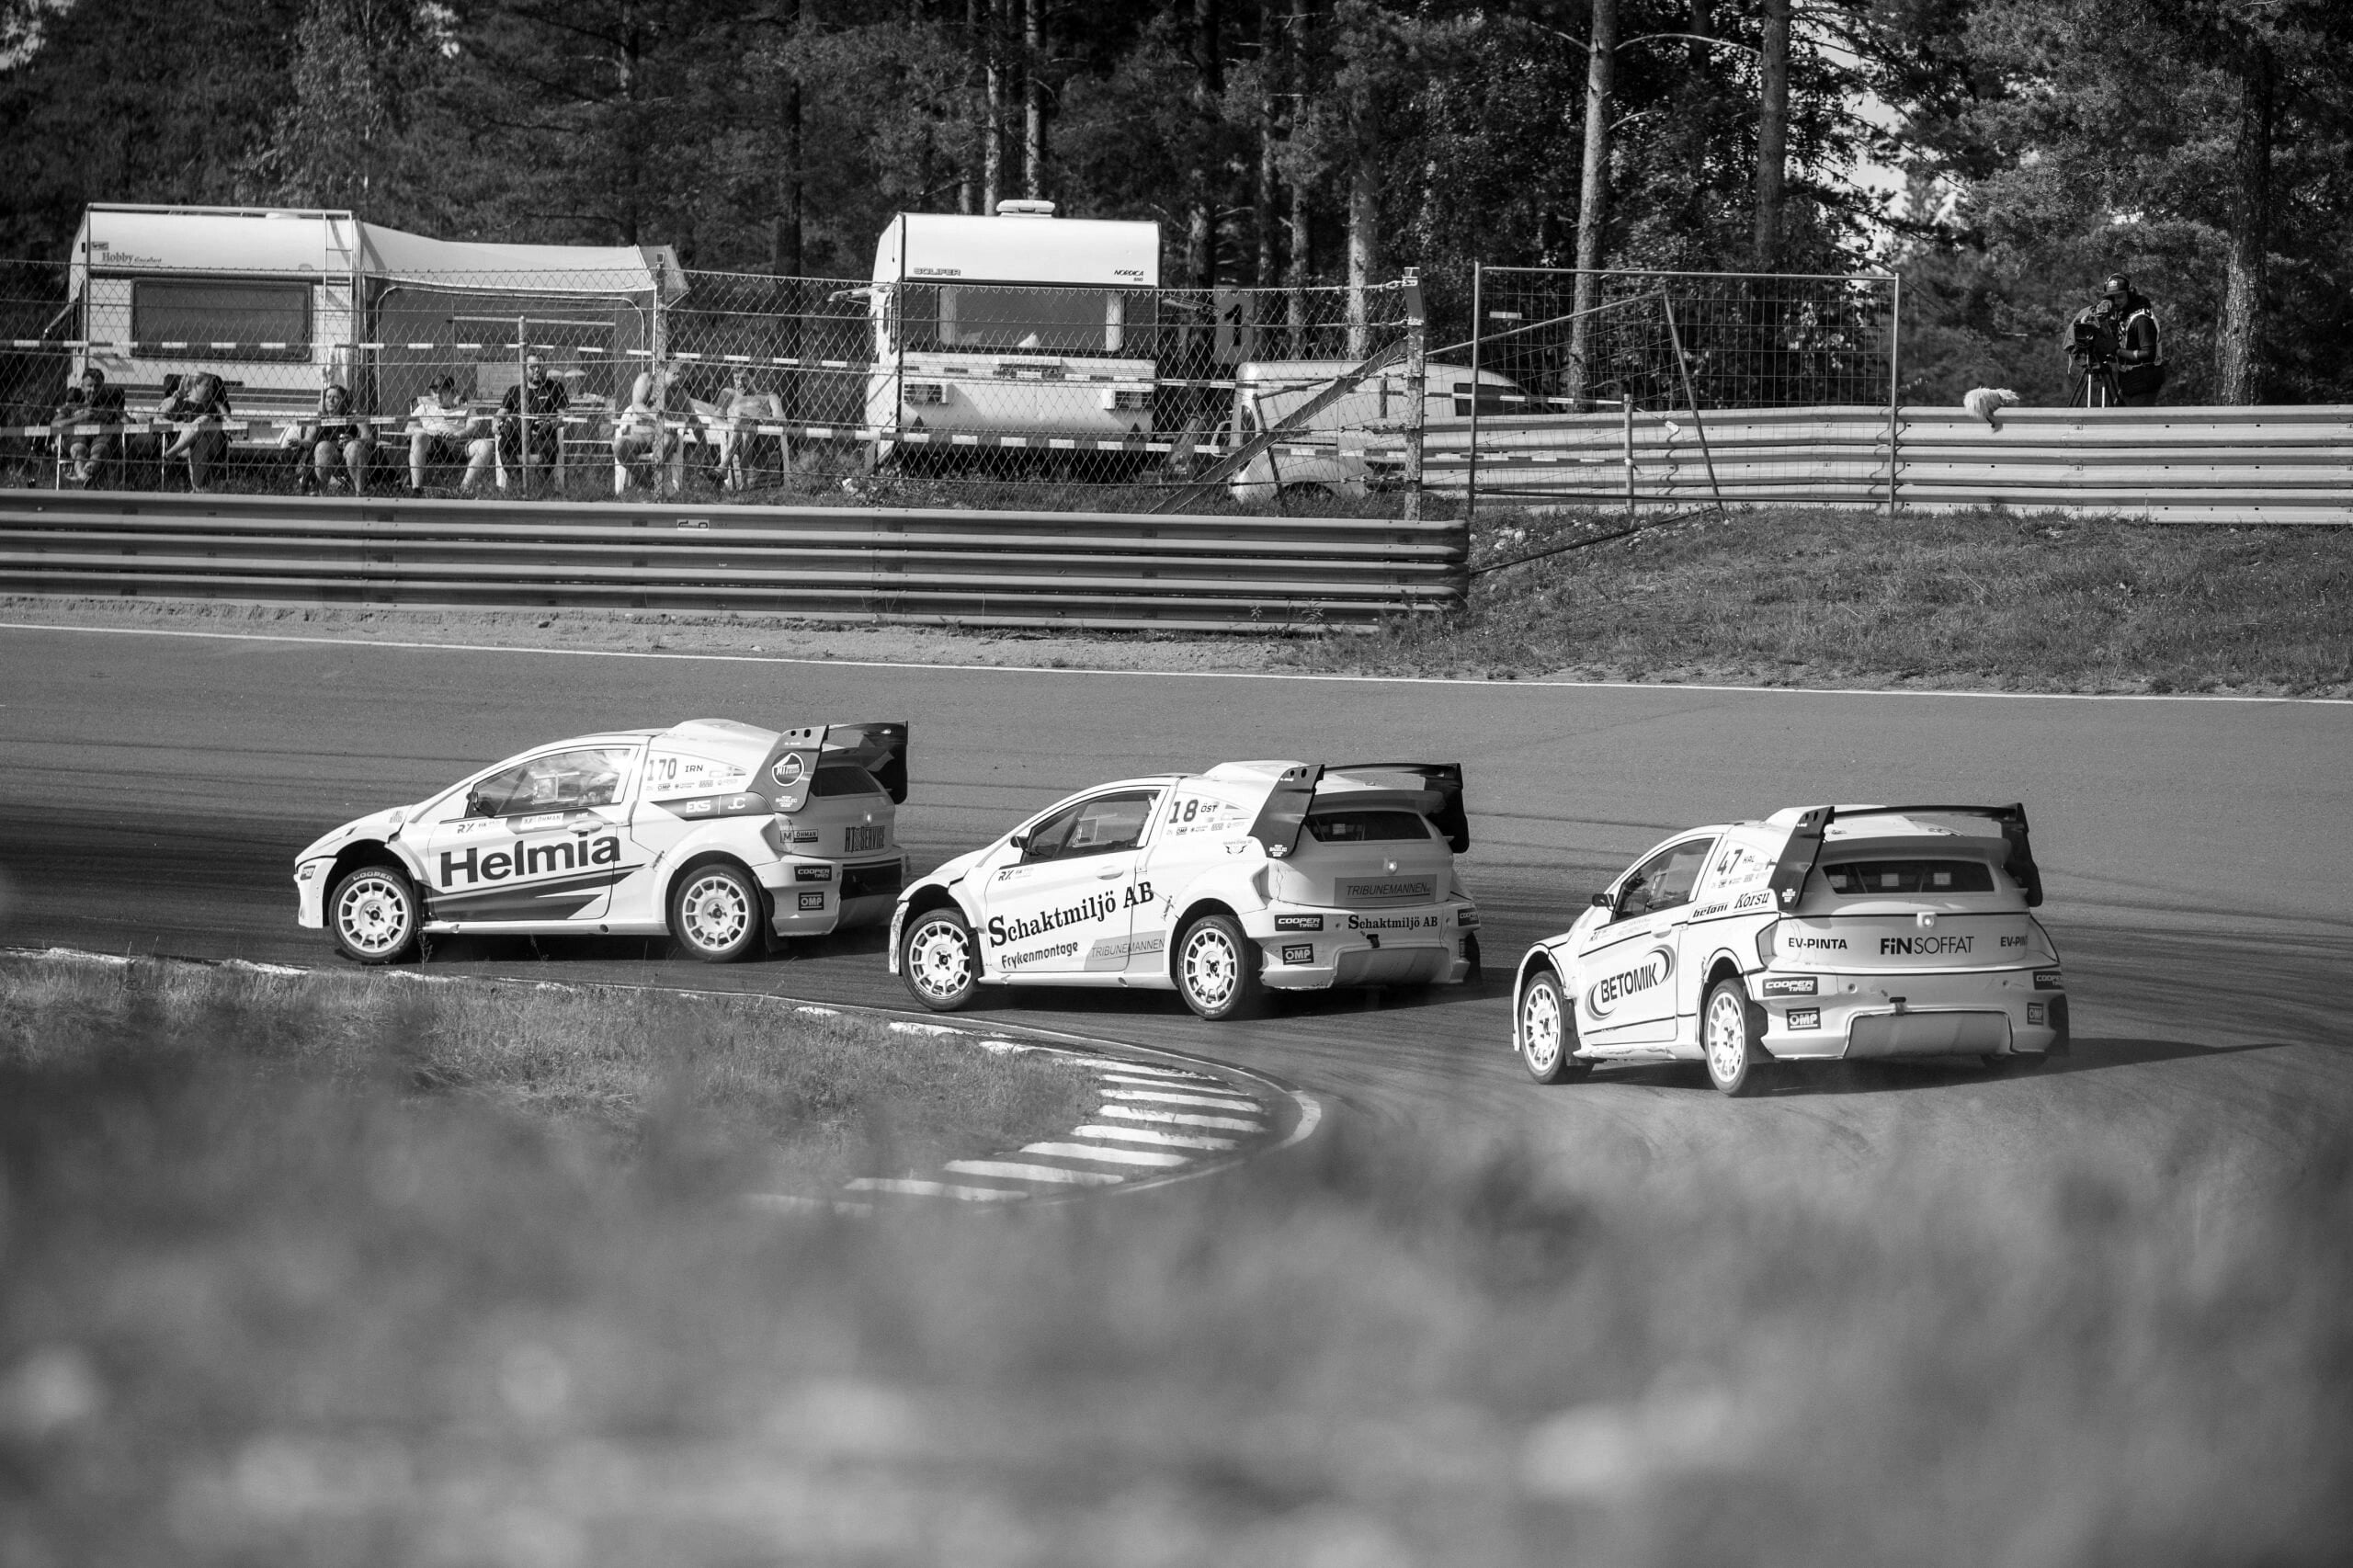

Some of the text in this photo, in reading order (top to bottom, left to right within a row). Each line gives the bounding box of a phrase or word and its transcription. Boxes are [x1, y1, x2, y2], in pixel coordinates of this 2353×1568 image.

[103, 253, 133, 265] Hobby
[1224, 303, 1243, 347] 1
[647, 757, 703, 781] 170 IRN
[1169, 799, 1199, 824] 18
[441, 831, 620, 887] Helmia
[1717, 848, 1744, 875] 47
[1346, 881, 1428, 897] TRIBUNEMANNEN
[801, 896, 823, 906] OMP
[1733, 892, 1770, 909] Korsu
[988, 881, 1154, 949] Schaktmiljö AB
[1348, 915, 1438, 931] Schaktmiljö AB
[1091, 937, 1165, 960] TRIBUNEMANNEN
[1788, 937, 1847, 949] EV-PINTA
[1001, 941, 1079, 970] Frykenmontage
[1285, 949, 1312, 960] OMP
[1600, 962, 1658, 1004] BETOMIK
[1765, 980, 1814, 990] COOPER
[1789, 1013, 1818, 1026] OMP
